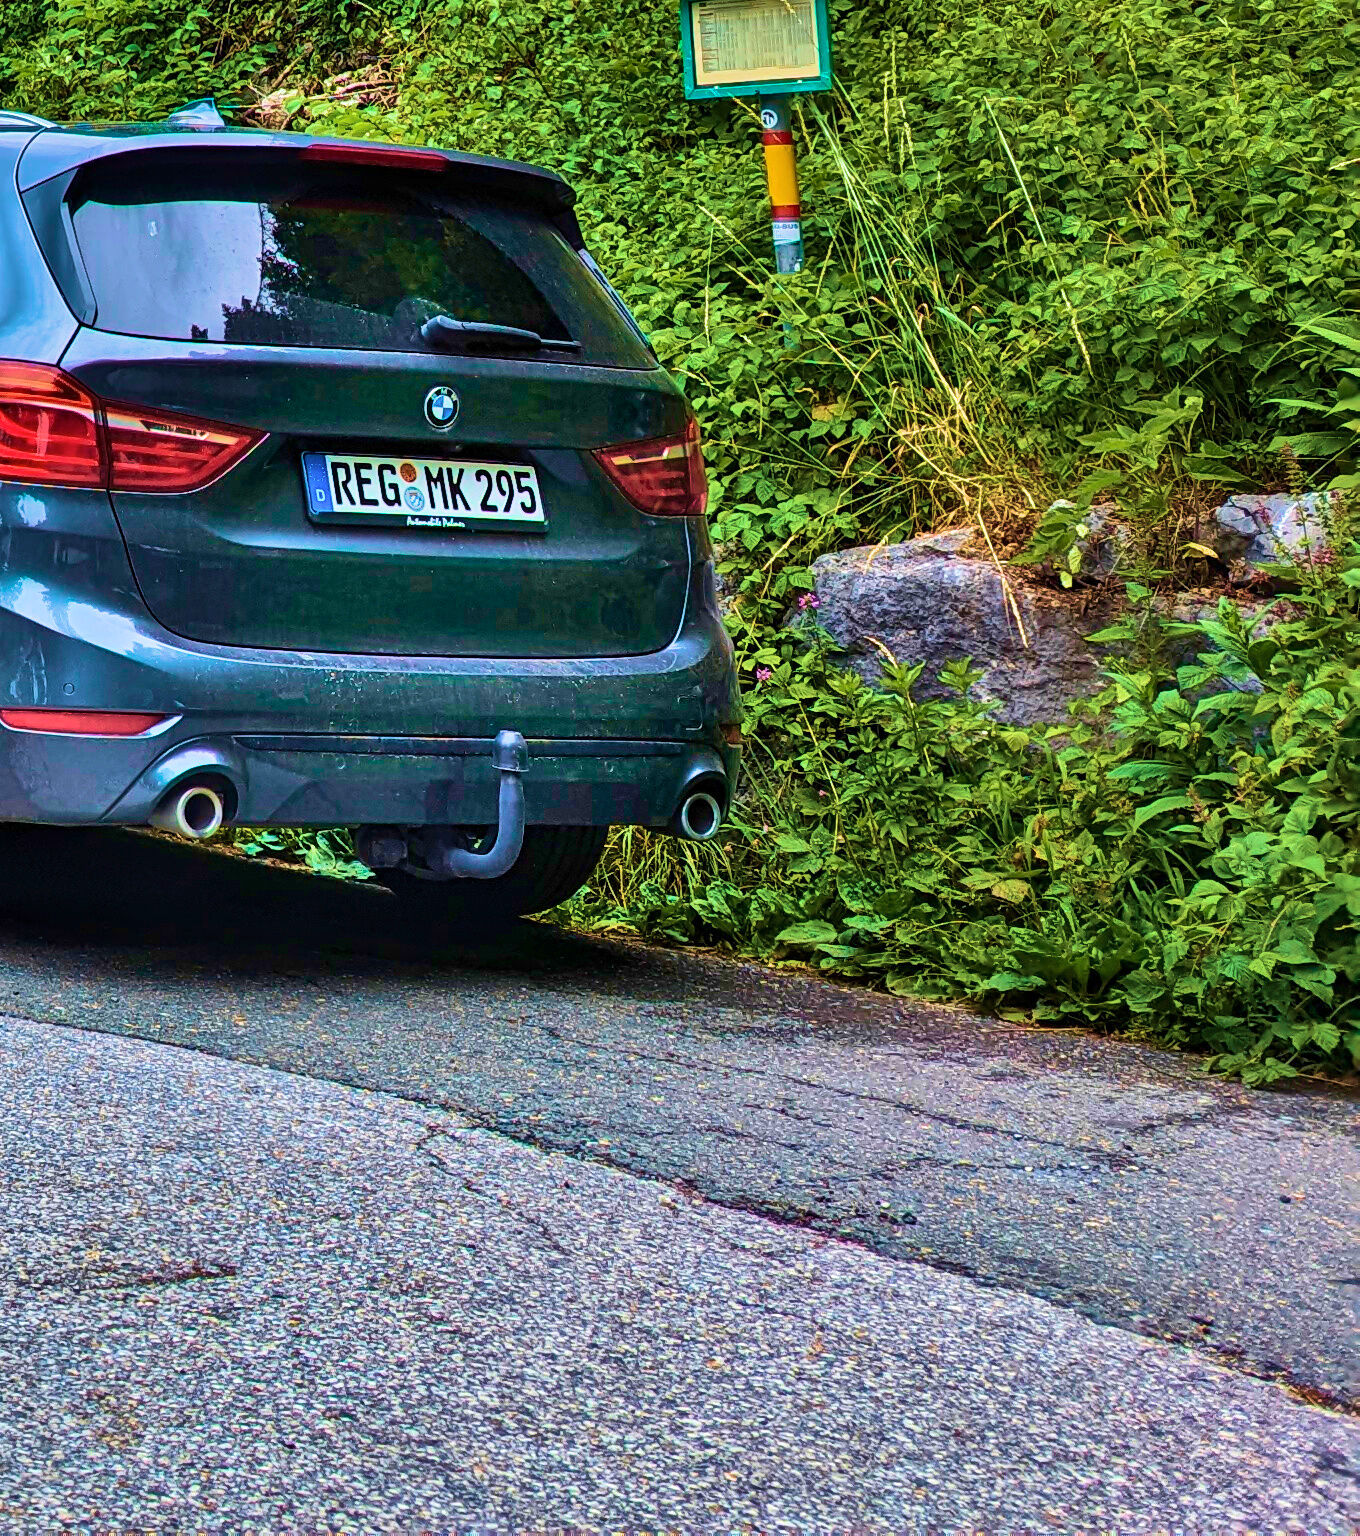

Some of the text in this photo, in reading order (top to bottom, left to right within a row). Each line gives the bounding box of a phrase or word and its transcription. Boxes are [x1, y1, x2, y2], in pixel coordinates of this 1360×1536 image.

[317, 489, 326, 502] D
[330, 461, 538, 514] REG MK 295
